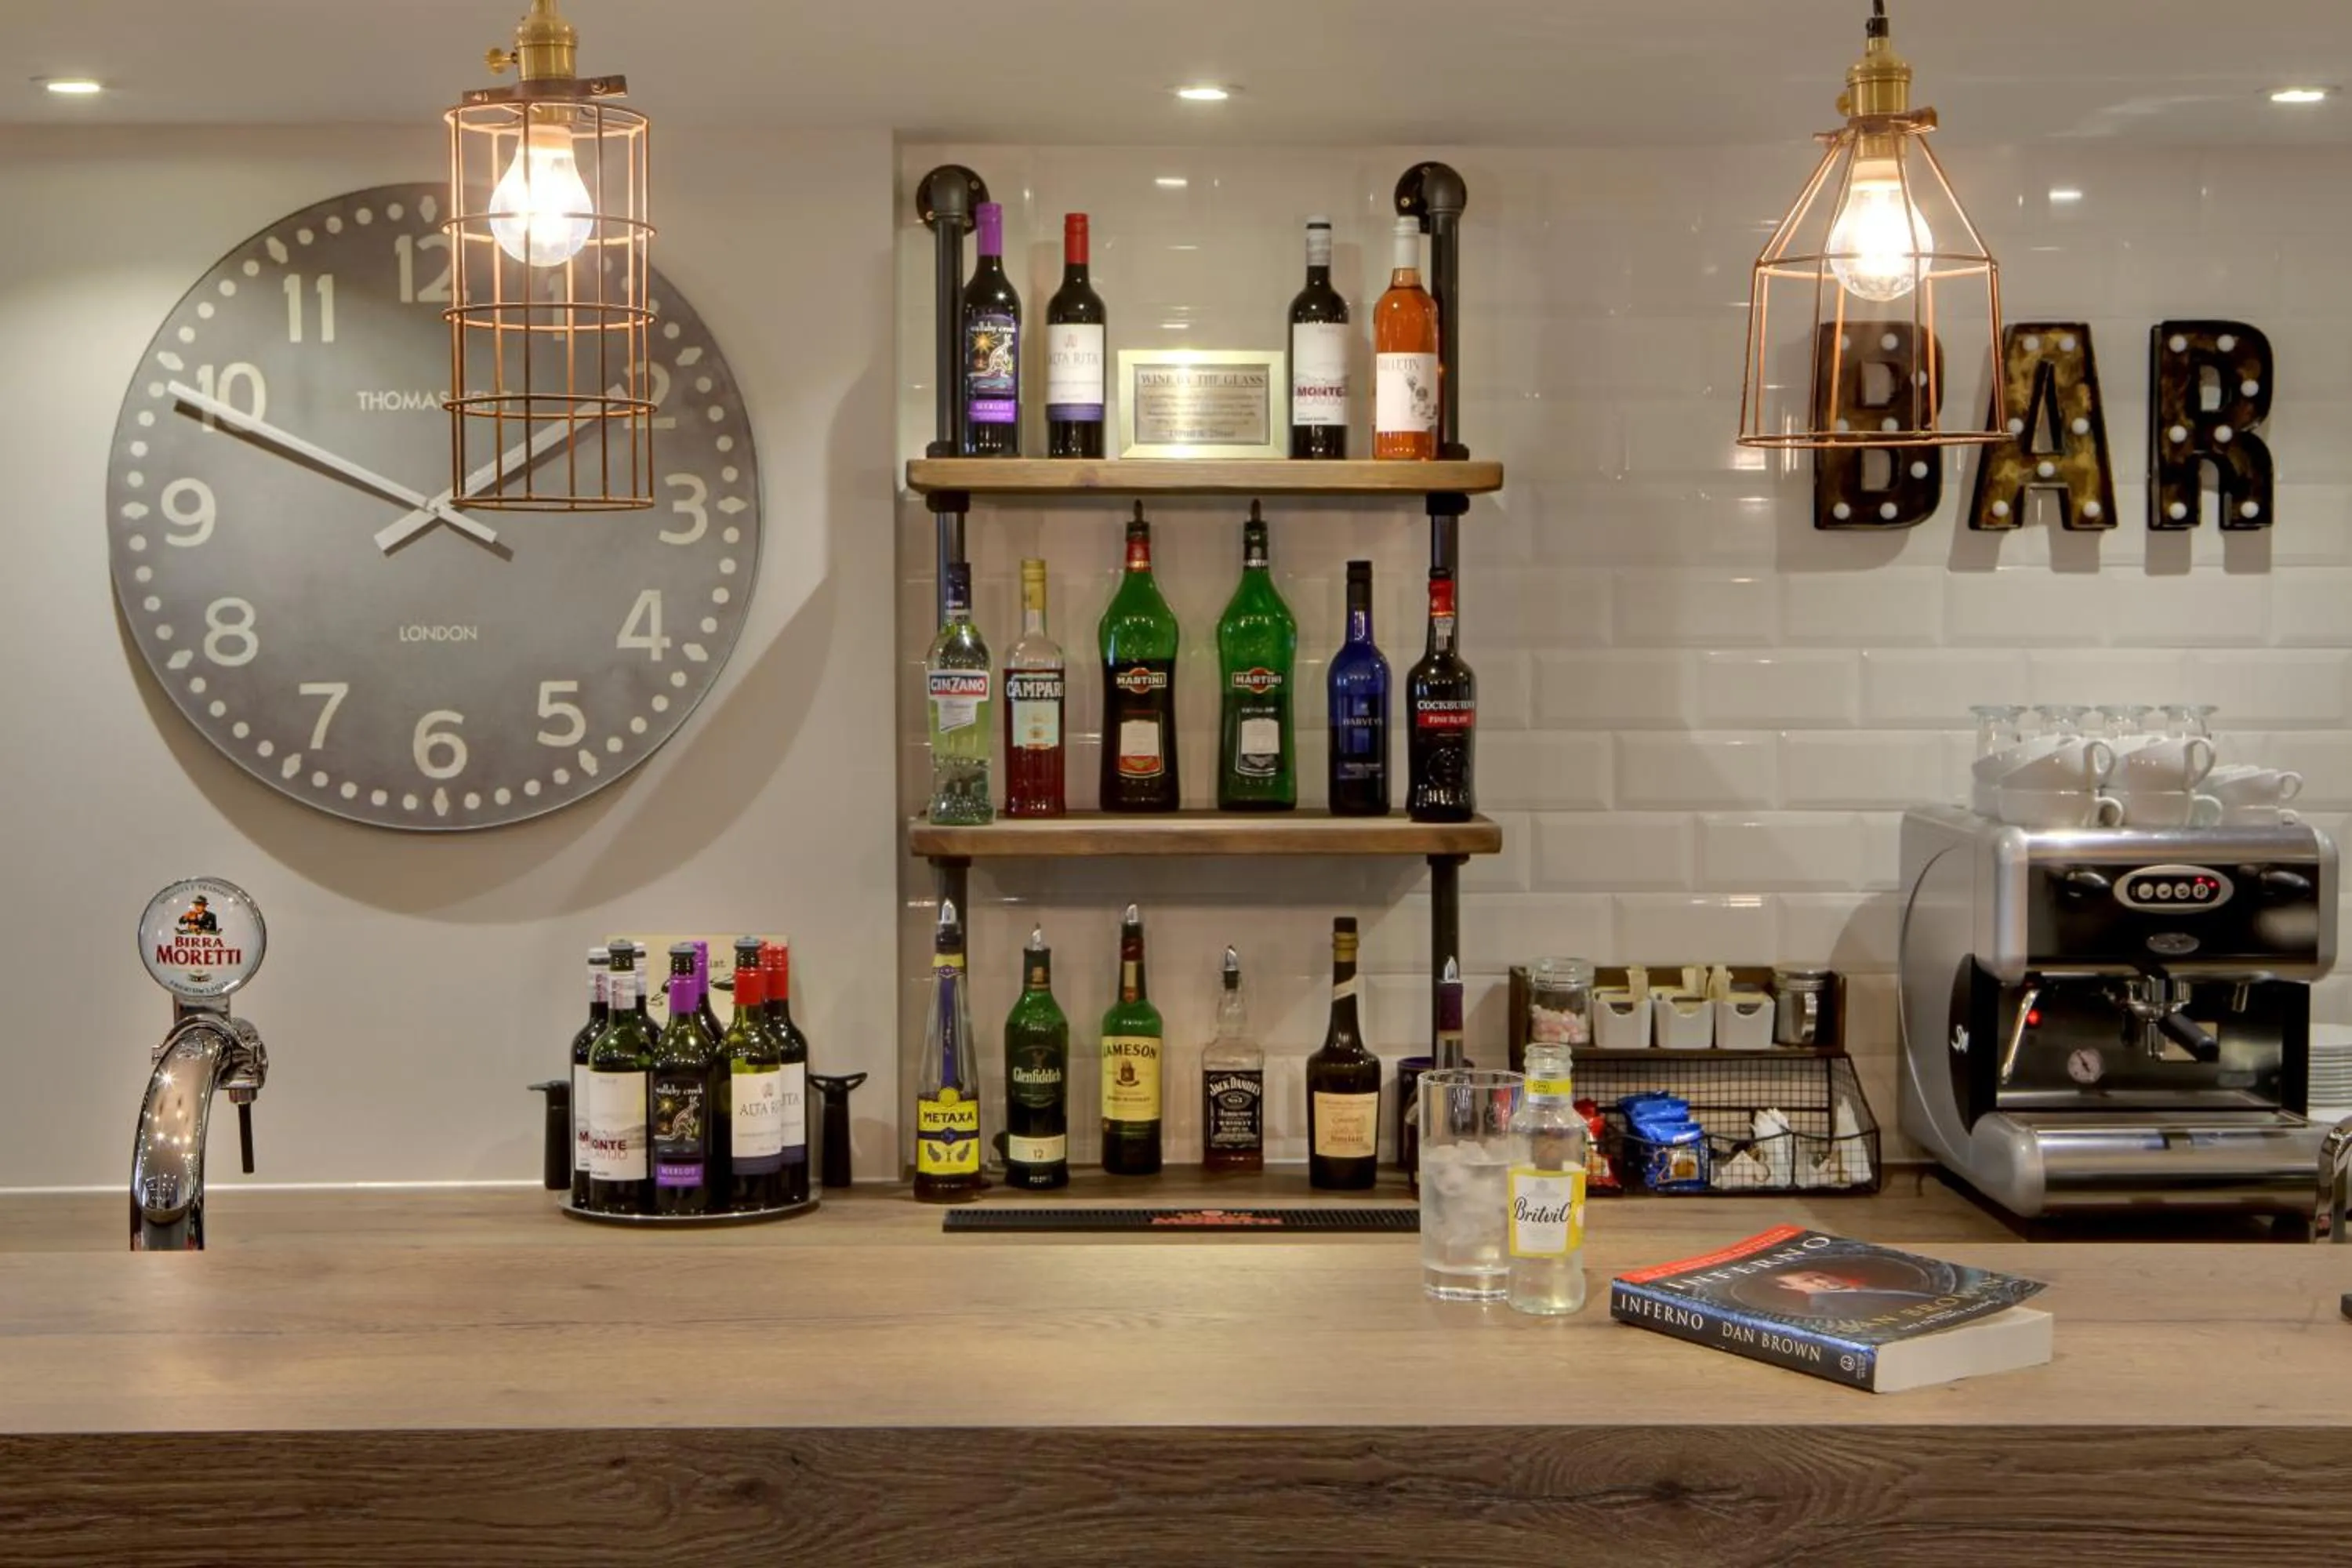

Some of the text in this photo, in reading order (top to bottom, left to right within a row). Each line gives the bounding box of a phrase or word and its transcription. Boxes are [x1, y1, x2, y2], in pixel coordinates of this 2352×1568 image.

[394, 234, 470, 303] 12
[283, 274, 335, 343] 11
[197, 362, 267, 432] 10
[357, 391, 450, 411] THOMAS
[623, 361, 676, 430] 2
[1142, 373, 1172, 384] WINE
[1224, 372, 1264, 384] GLASS
[1297, 386, 1343, 397] MONTE
[1813, 320, 2274, 531] BAR
[160, 477, 216, 546] 9
[658, 474, 709, 544] 3
[202, 597, 259, 666] 8
[399, 625, 477, 642] LONDON
[615, 590, 671, 661] 4
[931, 677, 985, 693] CINZANO
[1116, 676, 1163, 684] MARTINI
[1234, 675, 1282, 684] MARTINI
[299, 682, 349, 750] 7
[535, 681, 586, 747] 5
[412, 710, 468, 779] 6
[156, 944, 242, 966] MORETTI
[174, 936, 224, 948] BIRRA
[1012, 1066, 1062, 1083] Glenfiddich
[1103, 1043, 1156, 1058] JAMESON
[924, 1111, 974, 1123] METAXA
[1665, 1236, 1831, 1290] INFERNO
[1620, 1294, 1822, 1363] INFERNO DAN BROWN
